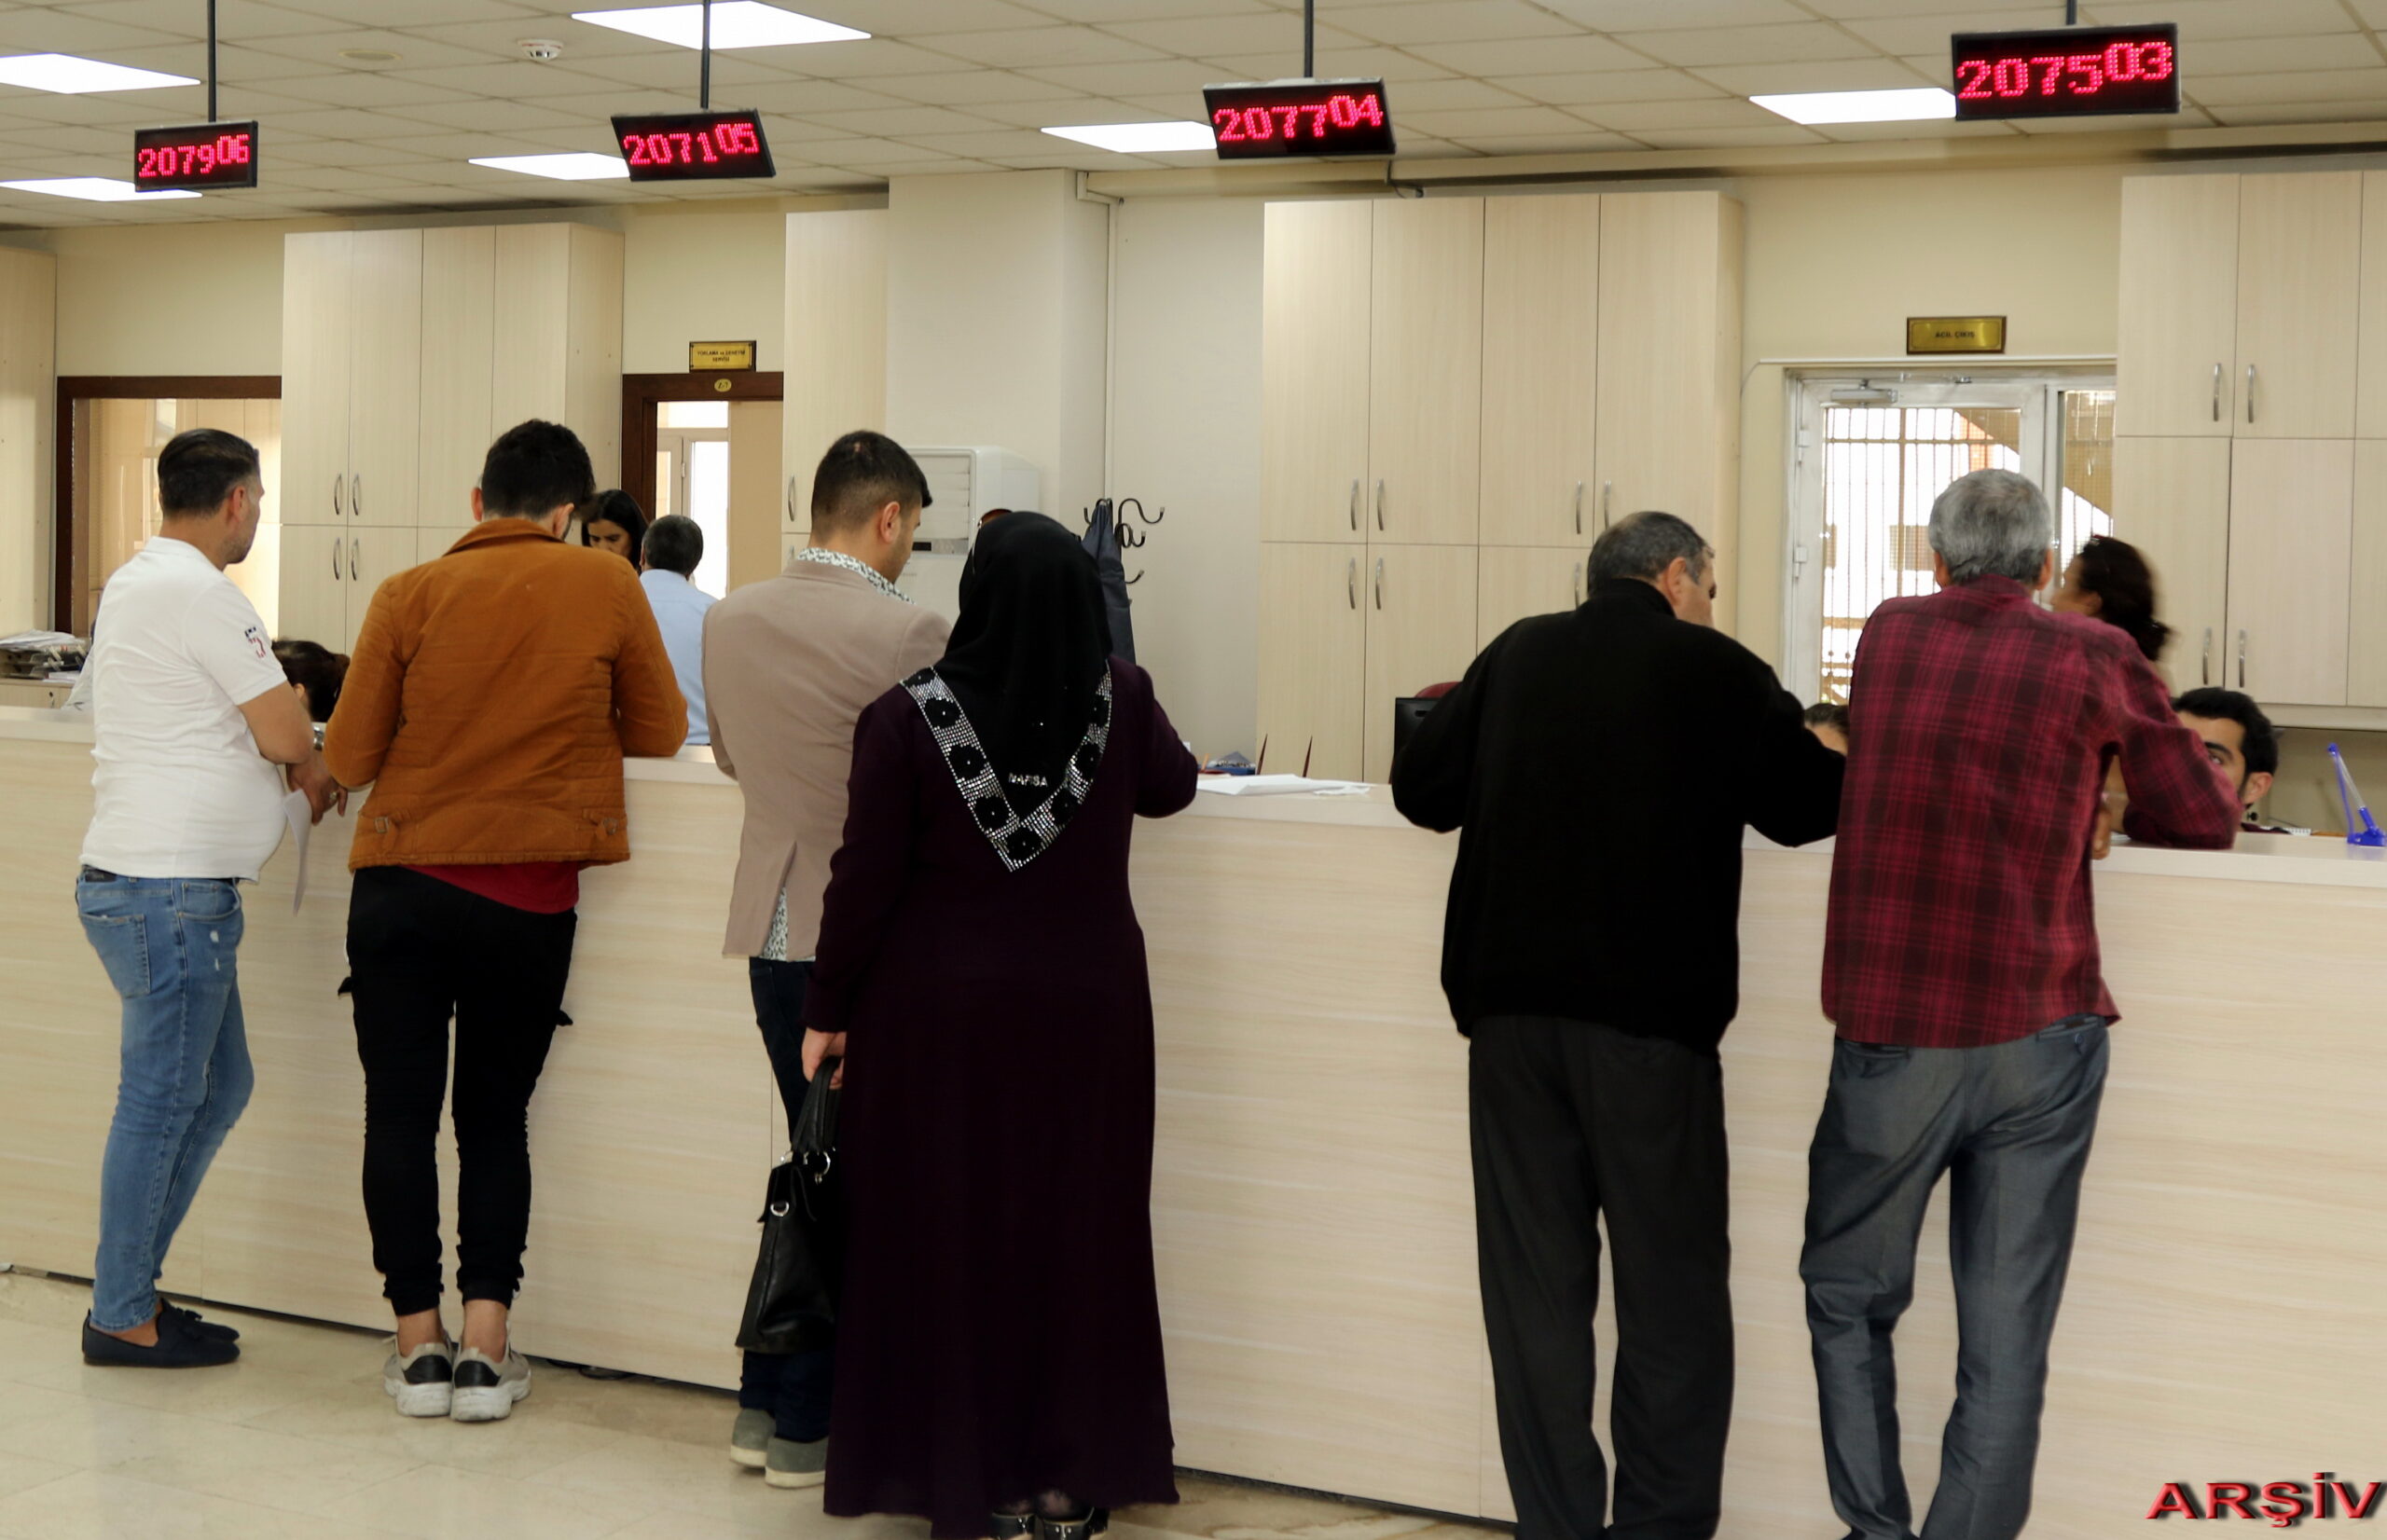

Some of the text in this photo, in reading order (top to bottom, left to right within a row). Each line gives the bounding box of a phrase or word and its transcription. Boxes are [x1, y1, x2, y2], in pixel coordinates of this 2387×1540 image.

[1957, 41, 2173, 99] 2075 03
[1214, 94, 1384, 141] 2077 04
[138, 133, 250, 178] 2079 06
[623, 122, 759, 165] 2071 05
